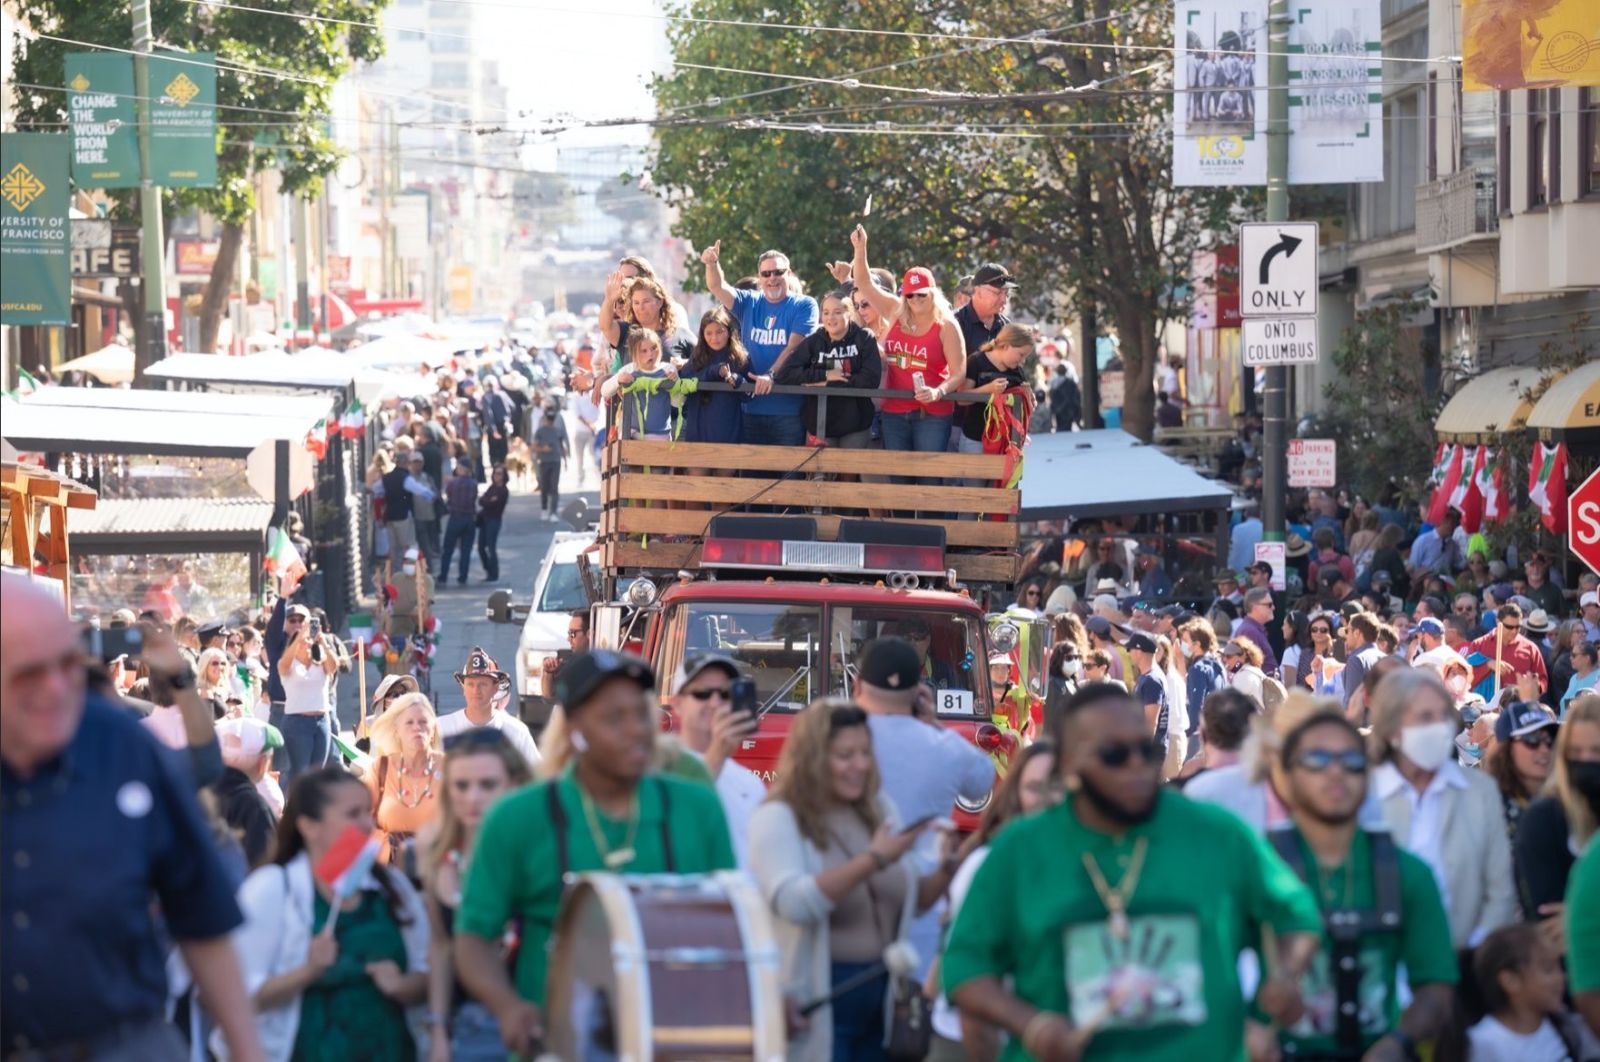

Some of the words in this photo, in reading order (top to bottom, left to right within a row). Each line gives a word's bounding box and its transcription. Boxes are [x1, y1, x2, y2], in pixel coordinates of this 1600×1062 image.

[1325, 42, 1366, 53] YEARS
[72, 95, 117, 108] CHANGE
[1309, 93, 1368, 106] MISSION
[72, 109, 95, 122] THE
[152, 110, 199, 118] UNIVERSITY
[201, 110, 213, 118] OF
[74, 122, 116, 136] WORLD
[75, 136, 108, 149] FROM
[76, 149, 108, 164] HERE.
[49, 217, 64, 227] OF
[3, 229, 64, 240] FRANCISCO
[1252, 290, 1305, 307] ONLY
[1, 303, 43, 311] USFCA.EDU
[751, 327, 787, 345] ITALIA
[1264, 322, 1296, 339] ONTO
[1248, 342, 1314, 360] COLUMBUS
[1288, 441, 1303, 455] NO
[1304, 445, 1333, 454] PARKING
[472, 657, 480, 667] 3
[944, 694, 962, 710] 81
